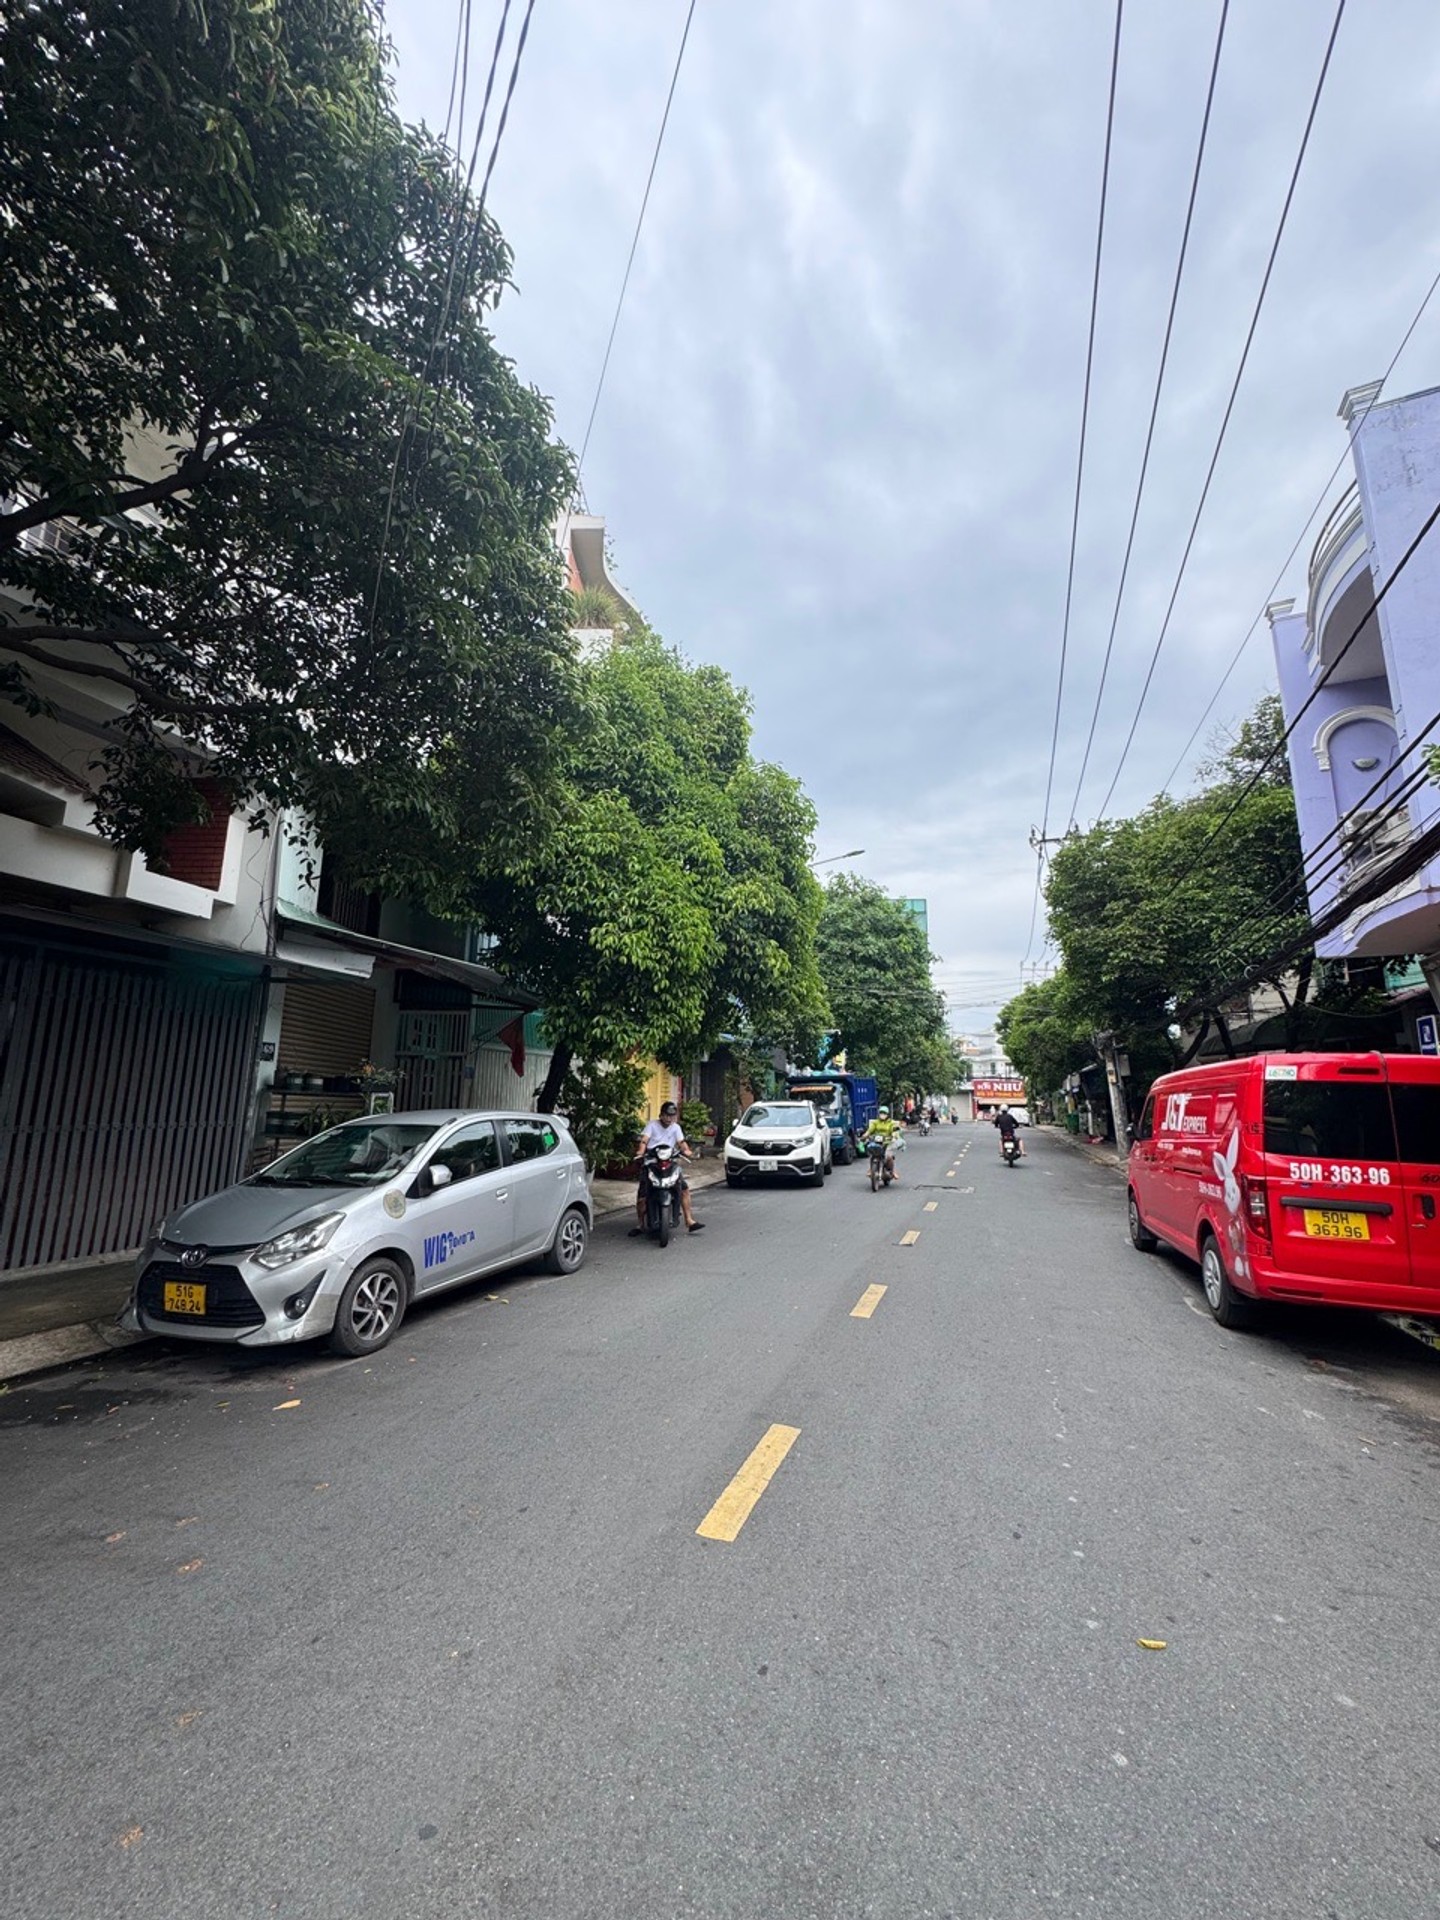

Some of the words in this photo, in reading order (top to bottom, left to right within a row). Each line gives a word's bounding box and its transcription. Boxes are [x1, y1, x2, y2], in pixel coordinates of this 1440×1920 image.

[1182, 1115, 1208, 1134] EXPRESS
[1321, 1211, 1350, 1225] 50H
[1313, 1223, 1363, 1239] 363.96
[175, 1285, 194, 1299] 51G
[168, 1297, 201, 1312] 748.24
